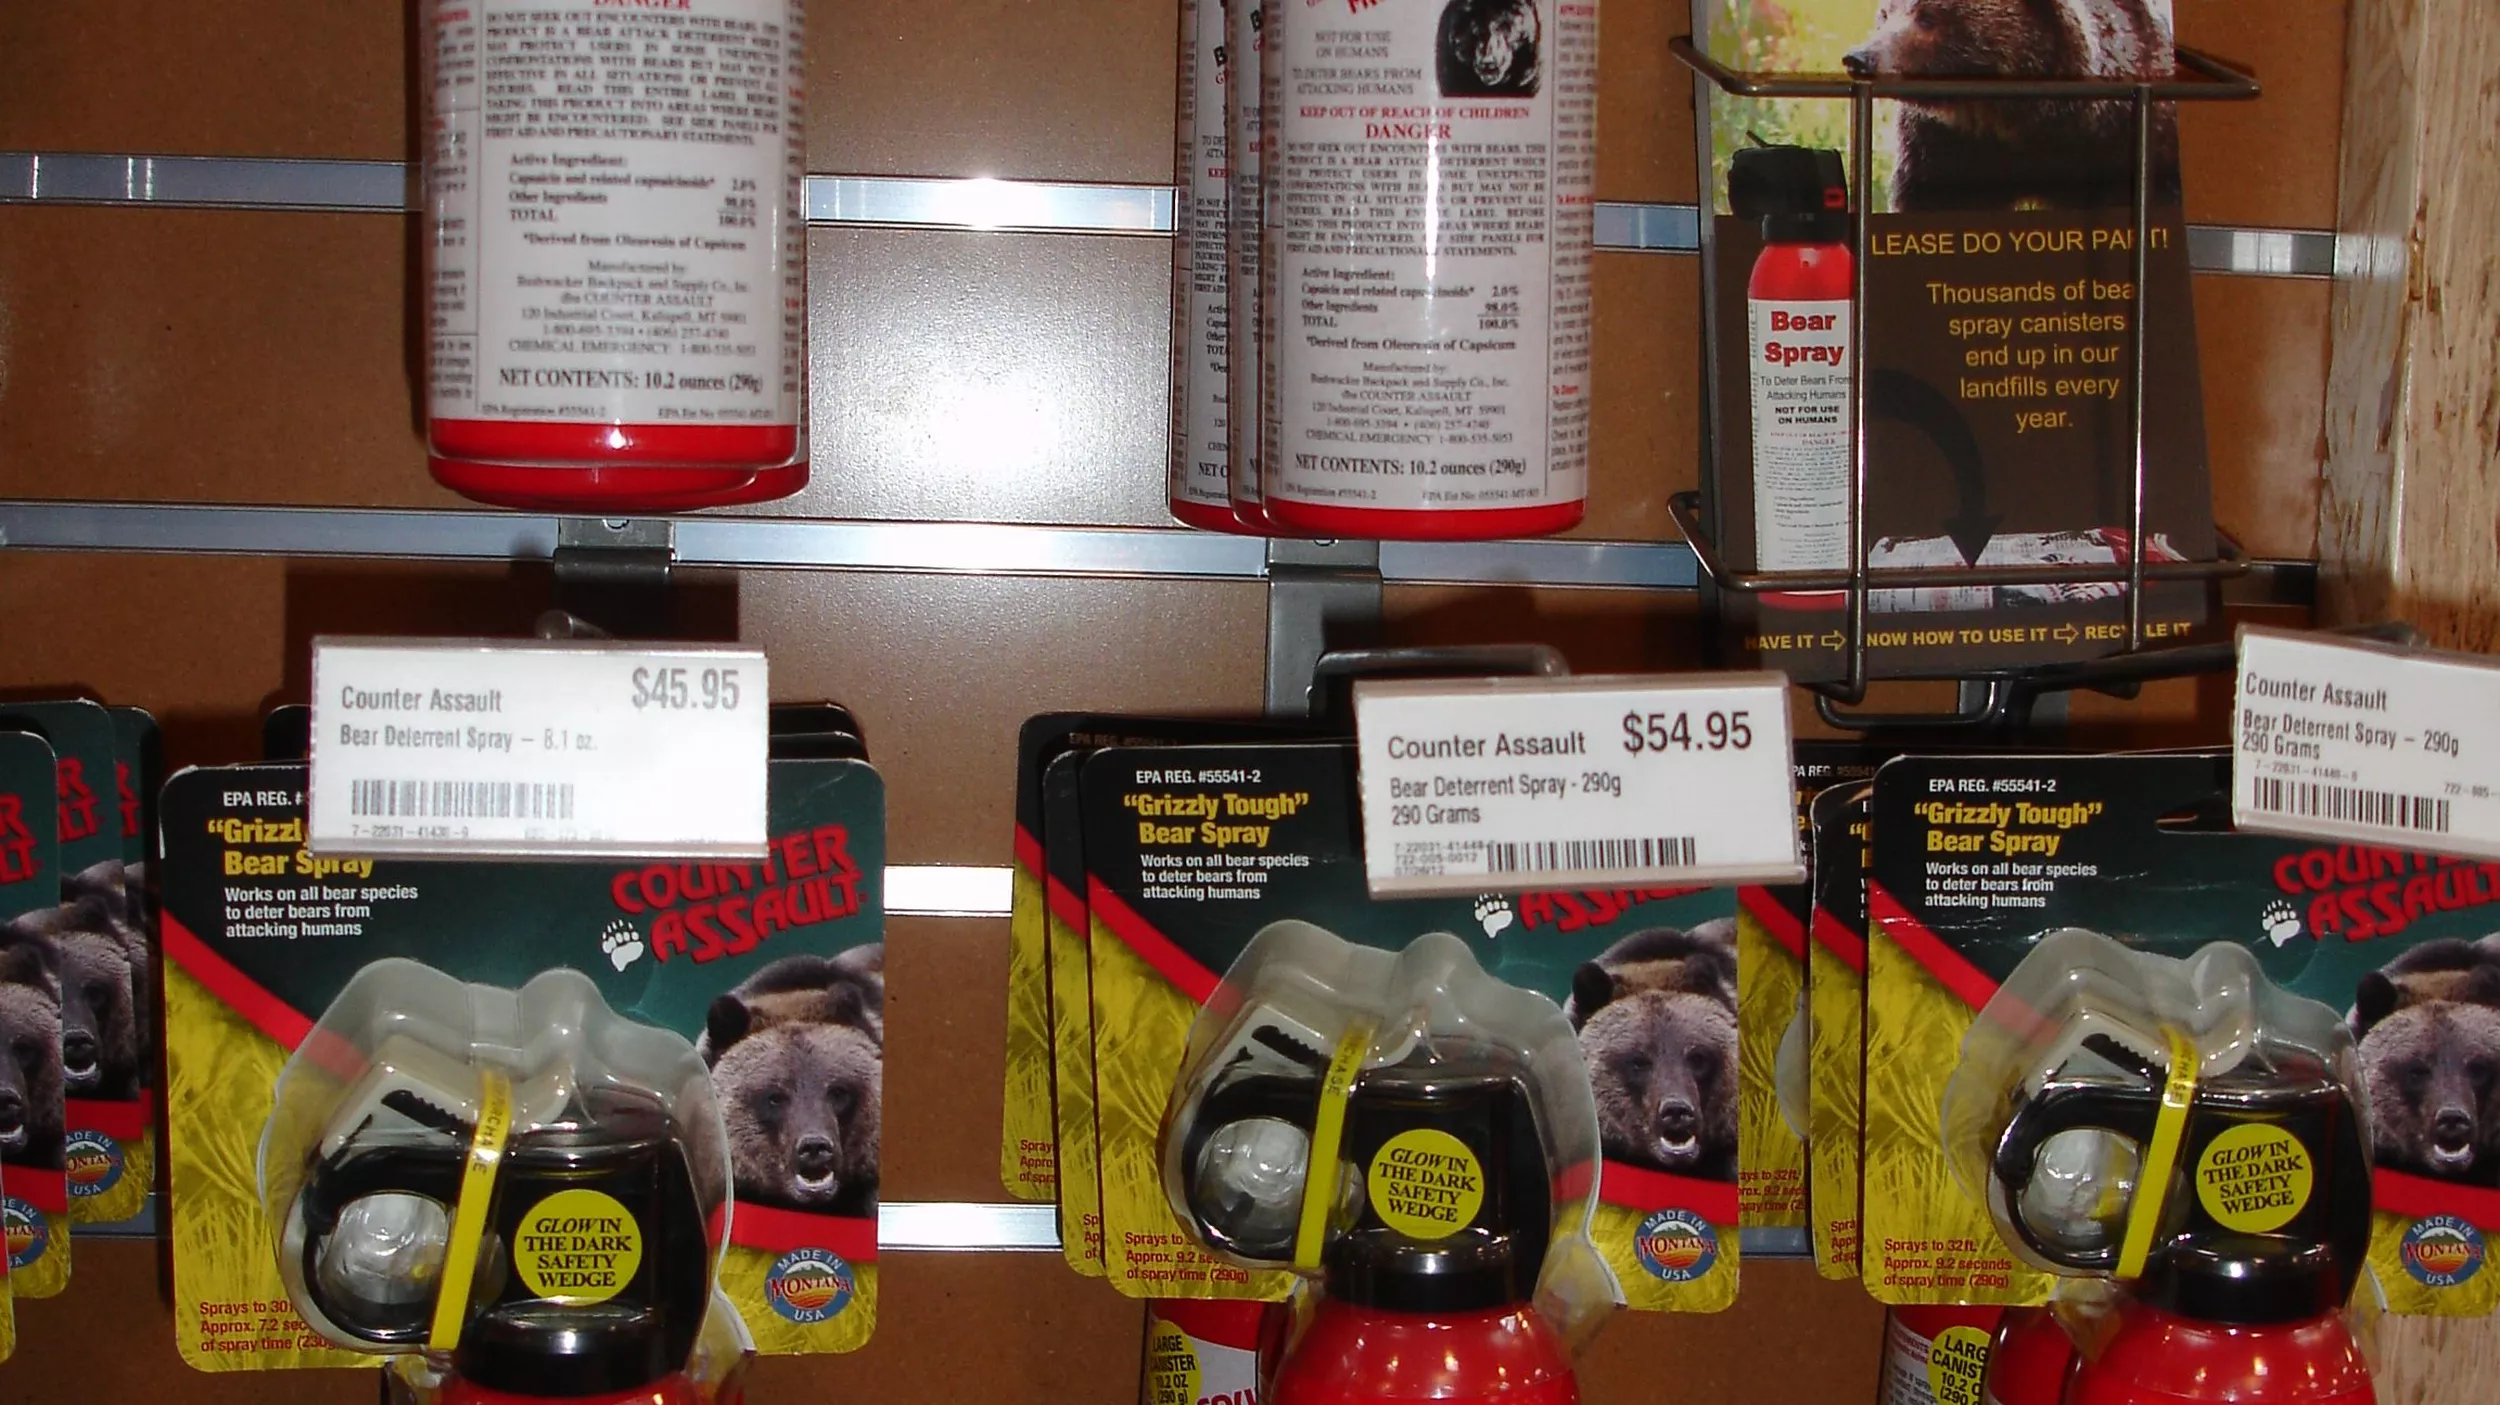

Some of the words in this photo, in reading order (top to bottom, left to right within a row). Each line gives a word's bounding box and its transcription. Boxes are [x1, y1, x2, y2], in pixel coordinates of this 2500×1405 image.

[1300, 107, 1327, 118] KEEP
[1330, 106, 1355, 117] OUT
[1359, 106, 1376, 117] OF
[1382, 106, 1430, 118] REACH
[1435, 107, 1453, 117] OF
[1459, 107, 1529, 118] CHILDREN
[1366, 123, 1452, 139] DANGER
[1872, 233, 1954, 254] LEASE
[1963, 232, 2001, 253] DO
[2012, 230, 2084, 252] YOUR
[1927, 282, 2055, 304] Thousands
[2063, 281, 2087, 302] of
[2093, 279, 2135, 300] bea
[1302, 316, 1337, 327] TOTAL
[1771, 311, 1836, 331] Bear
[1949, 317, 2012, 339] spray
[2020, 313, 2125, 333] canisters
[1351, 338, 1378, 349] from
[1443, 339, 1455, 350] of
[1765, 342, 1844, 367] Spray
[1965, 347, 2008, 367] end
[2017, 349, 2046, 371] up
[2053, 345, 2072, 365] in
[2080, 346, 2119, 365] our
[499, 368, 531, 388] NET
[535, 369, 639, 389] CONTENTS:
[645, 372, 675, 389] 10.2
[679, 378, 725, 389] ounces
[1960, 377, 2046, 399] landfills
[2055, 377, 2120, 400] every
[1810, 391, 1846, 399] Humans
[1795, 416, 1837, 424] HUMANS
[2016, 411, 2073, 434] year.
[1296, 453, 1316, 469] NET
[1321, 457, 1403, 474] CONTENTS:
[1409, 461, 1437, 475] 10.2
[1440, 465, 1486, 475] ounces
[1489, 458, 1526, 475] (290g)
[1867, 632, 1907, 647] NOW
[1913, 631, 1954, 646] HOW
[1960, 629, 1983, 644] TO
[1989, 629, 2024, 642] USE
[2030, 628, 2048, 641] IT
[2173, 622, 2191, 635] IT
[1797, 634, 1814, 648] IT
[632, 667, 739, 710] $45.95
[2246, 672, 2316, 702] Counter
[2323, 683, 2387, 712] Assault
[341, 686, 422, 712] Counter
[429, 687, 502, 713] Assault
[340, 724, 379, 747] Bear
[384, 726, 461, 749] Deterrent
[467, 727, 513, 752] Spray
[544, 729, 568, 749] 8.1
[576, 733, 598, 750] oz.
[1623, 710, 1752, 758] $54.95
[2244, 709, 2277, 731] Bear
[2283, 714, 2349, 741] Deterrent
[2355, 723, 2396, 749] Spray
[2424, 730, 2458, 757] 290g
[1388, 736, 1485, 759] Counter
[1495, 732, 1586, 756] Assault
[2243, 732, 2267, 751] 290
[2274, 736, 2320, 759] Grams
[1137, 771, 1161, 783] EPA
[1165, 771, 1195, 783] REG.
[1199, 770, 1261, 783] #55541-2
[1391, 778, 1427, 798] Bear
[1434, 776, 1513, 797] Deterrent
[1519, 775, 1566, 799] Spray
[1582, 773, 1620, 796] 290g
[1929, 780, 1954, 792] EPA
[1959, 780, 1989, 792] REG.
[1993, 780, 2056, 793] #55541-2
[223, 791, 252, 807] EPA
[257, 791, 291, 805] REG.
[1392, 805, 1421, 825] 290
[1426, 805, 1481, 824] Grams
[1140, 823, 1195, 843] Bear
[1201, 823, 1269, 848] Spray
[1927, 832, 1984, 852] Bear
[1990, 831, 2060, 856] Spray
[224, 852, 289, 876] Bear
[297, 852, 373, 879] Spray
[1141, 854, 1182, 867] Works
[1187, 856, 1202, 866] on
[1206, 854, 1222, 866] all
[1226, 854, 1254, 867] bear
[1258, 854, 1309, 868] species
[1142, 871, 1155, 882] to
[1159, 871, 1192, 882] deter
[1196, 870, 1232, 882] bears
[1237, 871, 1267, 882] from
[1143, 886, 1205, 900] attacking
[1208, 887, 1260, 899] humans
[650, 872, 864, 965] ASSAULT
[74, 1184, 101, 1195] USA
[536, 1218, 597, 1234] GLOW
[599, 1217, 621, 1233] IN
[2412, 1216, 2454, 1235] MADE
[2458, 1221, 2473, 1237] IN
[524, 1237, 567, 1252] THE
[571, 1236, 632, 1251] DARK
[1885, 1239, 1927, 1254] Sprays
[1932, 1240, 1944, 1251] to
[2405, 1240, 2480, 1261] MONTANA
[537, 1254, 617, 1269] SAFETY
[778, 1249, 821, 1271] MADE
[826, 1254, 842, 1269] IN
[1884, 1258, 1932, 1271] Approx.
[1936, 1258, 1955, 1269] 9.2
[1958, 1258, 2012, 1270] seconds
[539, 1272, 615, 1287] WEDGE
[770, 1275, 851, 1300] MONTANA
[1884, 1274, 1898, 1286] of
[1900, 1275, 1934, 1289] spray
[1938, 1275, 1965, 1286] time
[1969, 1274, 2008, 1289] (290g)
[2427, 1274, 2454, 1285] USA
[794, 1310, 824, 1321] USA
[201, 1321, 255, 1335] Approx.
[259, 1319, 278, 1331] 7.2
[202, 1339, 214, 1352] of
[219, 1339, 258, 1352] spray
[262, 1337, 292, 1349] time
